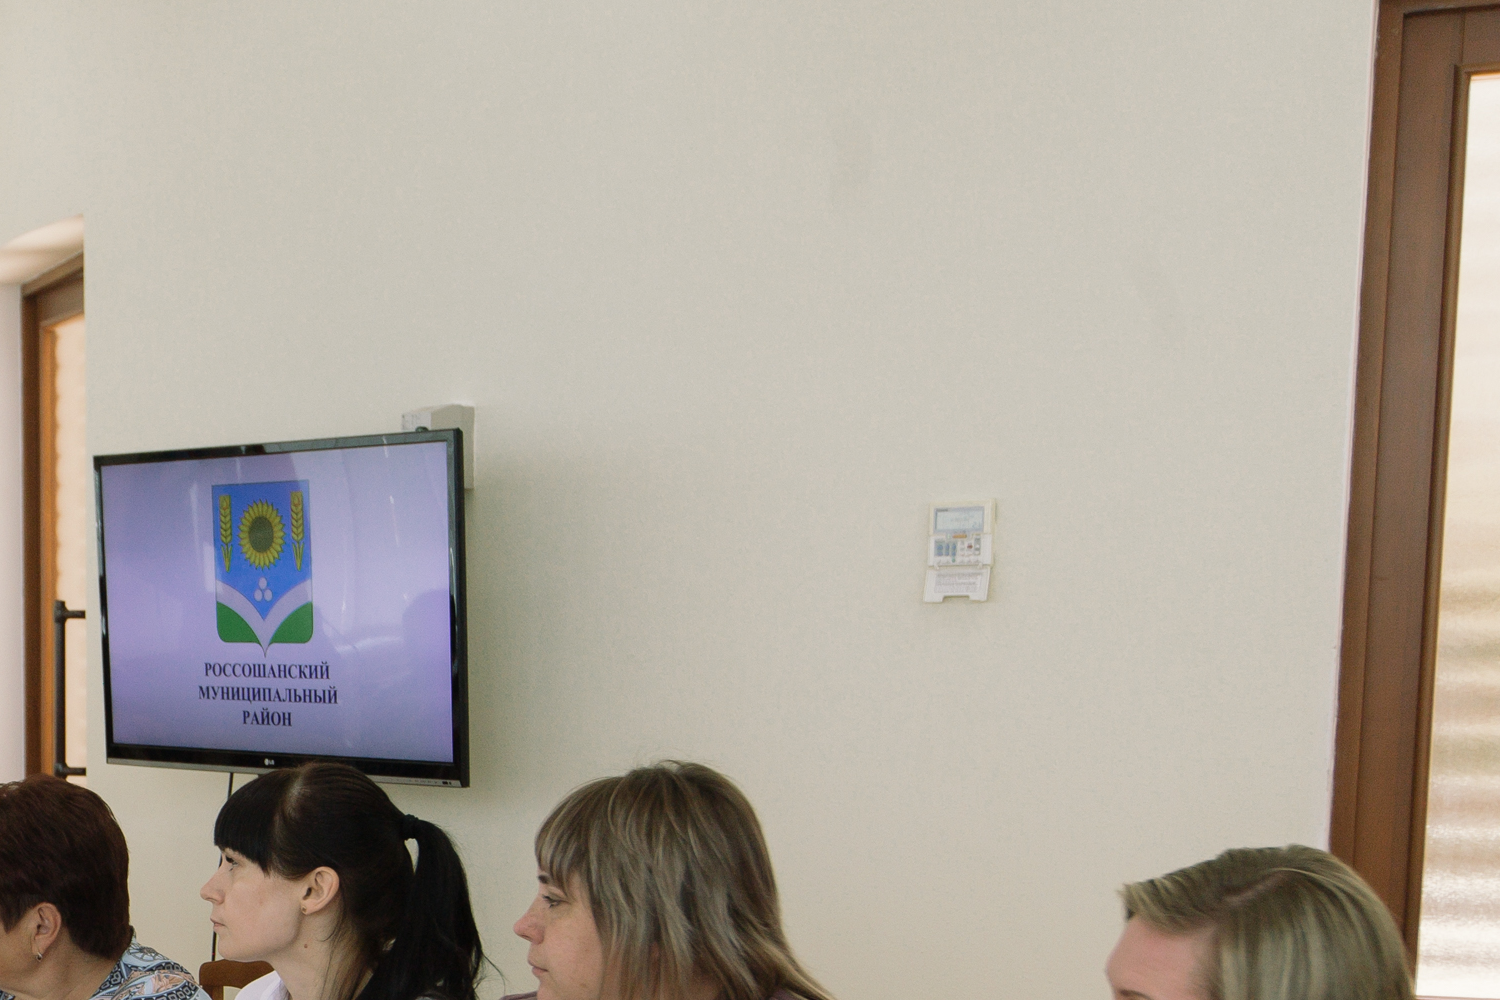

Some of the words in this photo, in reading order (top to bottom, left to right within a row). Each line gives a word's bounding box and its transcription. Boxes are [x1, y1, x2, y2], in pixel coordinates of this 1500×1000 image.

[204, 661, 330, 680] РОССОШАНСКИЙ
[198, 685, 338, 704] МУНИЦИПАЛЬНЫЙ
[242, 707, 292, 727] РАЙОН
